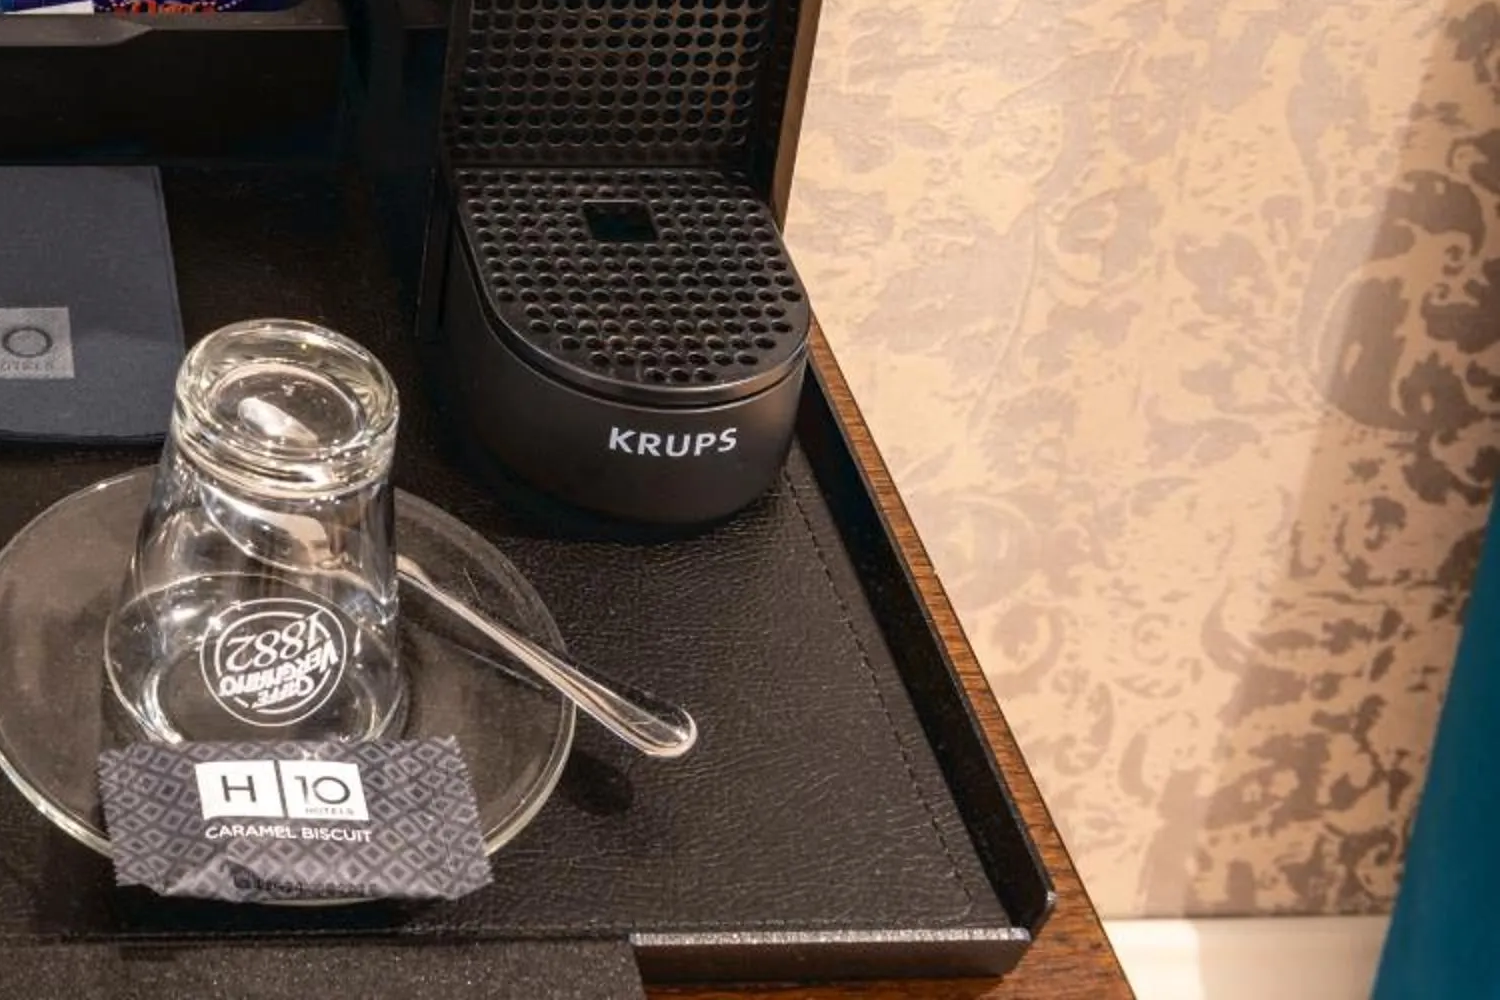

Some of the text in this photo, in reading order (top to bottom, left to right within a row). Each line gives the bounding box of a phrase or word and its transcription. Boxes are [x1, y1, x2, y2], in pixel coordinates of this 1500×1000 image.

[609, 426, 737, 457] KRUPS
[226, 609, 324, 672] 1882
[205, 823, 373, 843] CARAMEL BISCUIT
